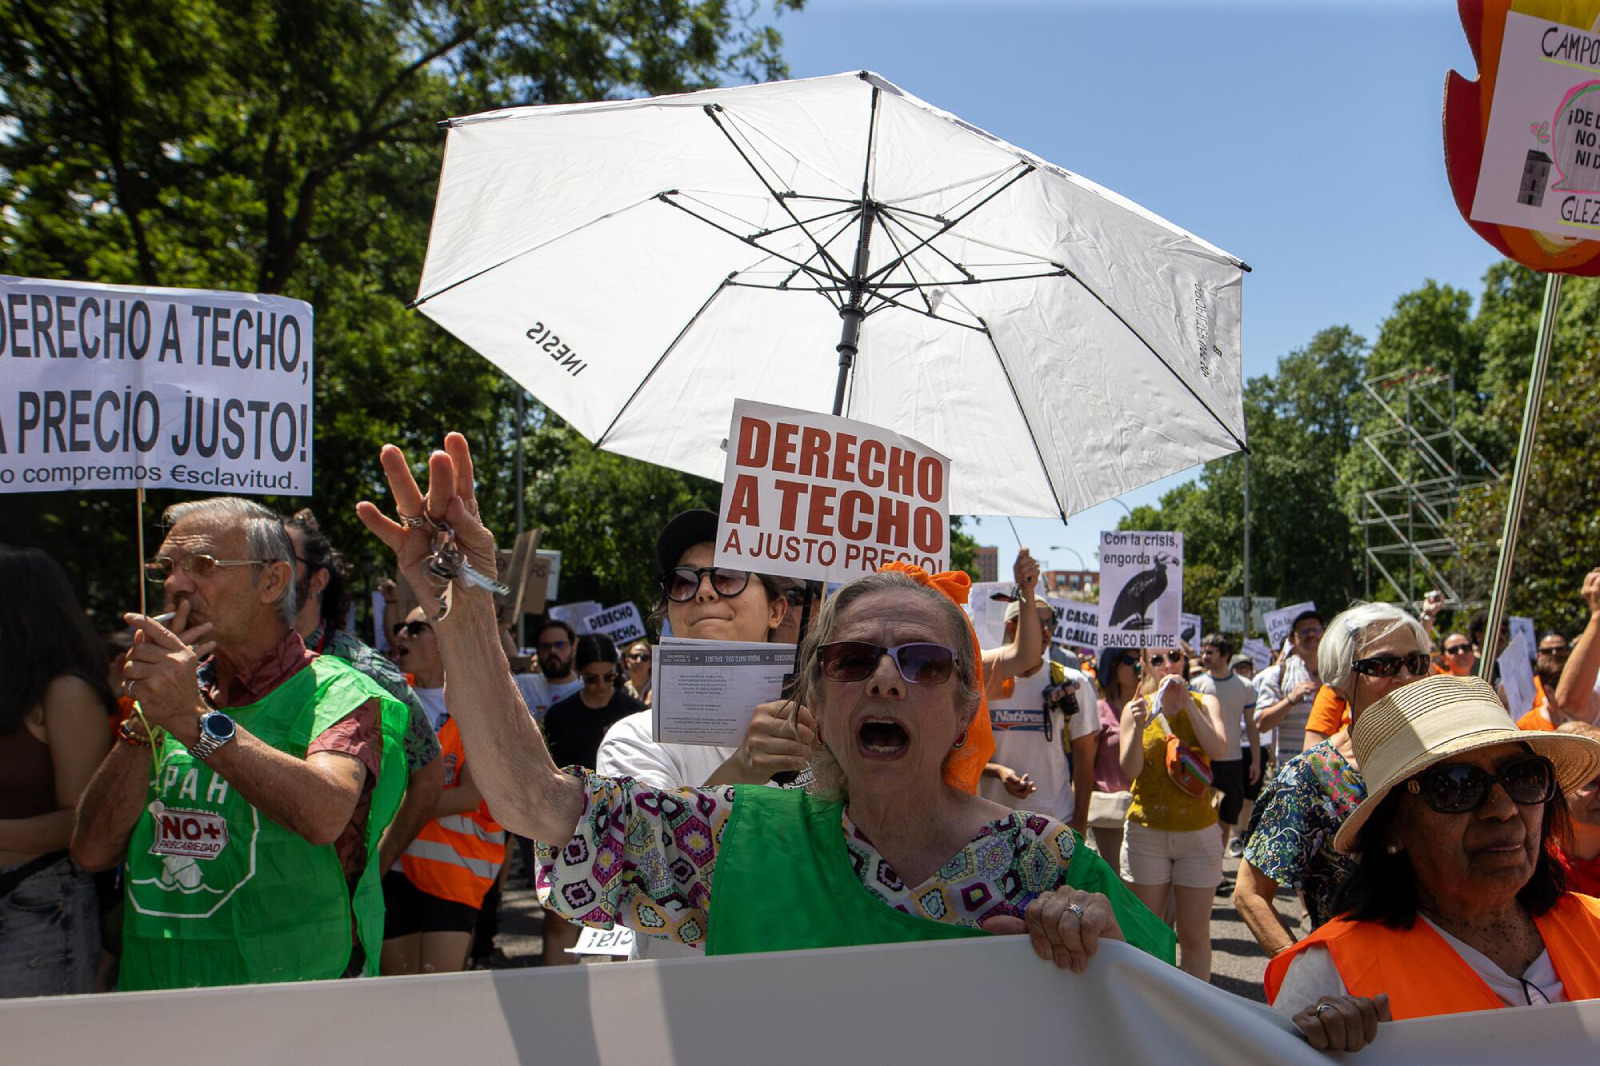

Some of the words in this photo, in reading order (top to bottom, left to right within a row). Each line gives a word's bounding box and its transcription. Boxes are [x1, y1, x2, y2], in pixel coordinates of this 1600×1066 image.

[1541, 26, 1600, 66] CAMPO
[1575, 129, 1597, 148] NO
[1575, 149, 1591, 167] NI
[158, 304, 183, 363] A
[192, 305, 309, 385] TECHO,
[736, 416, 943, 503] DERECHO
[23, 465, 162, 485] compremos
[170, 464, 299, 489] €sclavitud.
[726, 474, 760, 527] A
[774, 479, 943, 554] TECHO
[722, 529, 742, 555] A
[750, 532, 837, 567] JUSTO
[1104, 532, 1127, 545] Con
[1131, 533, 1141, 546] la
[1144, 534, 1178, 549] crisis,
[1104, 551, 1150, 567] engorda
[589, 605, 633, 630] DERECHO
[1102, 634, 1137, 647] BANCO
[1140, 634, 1177, 648] BUITRE.
[162, 765, 230, 804] PAH
[162, 814, 221, 841] NO+
